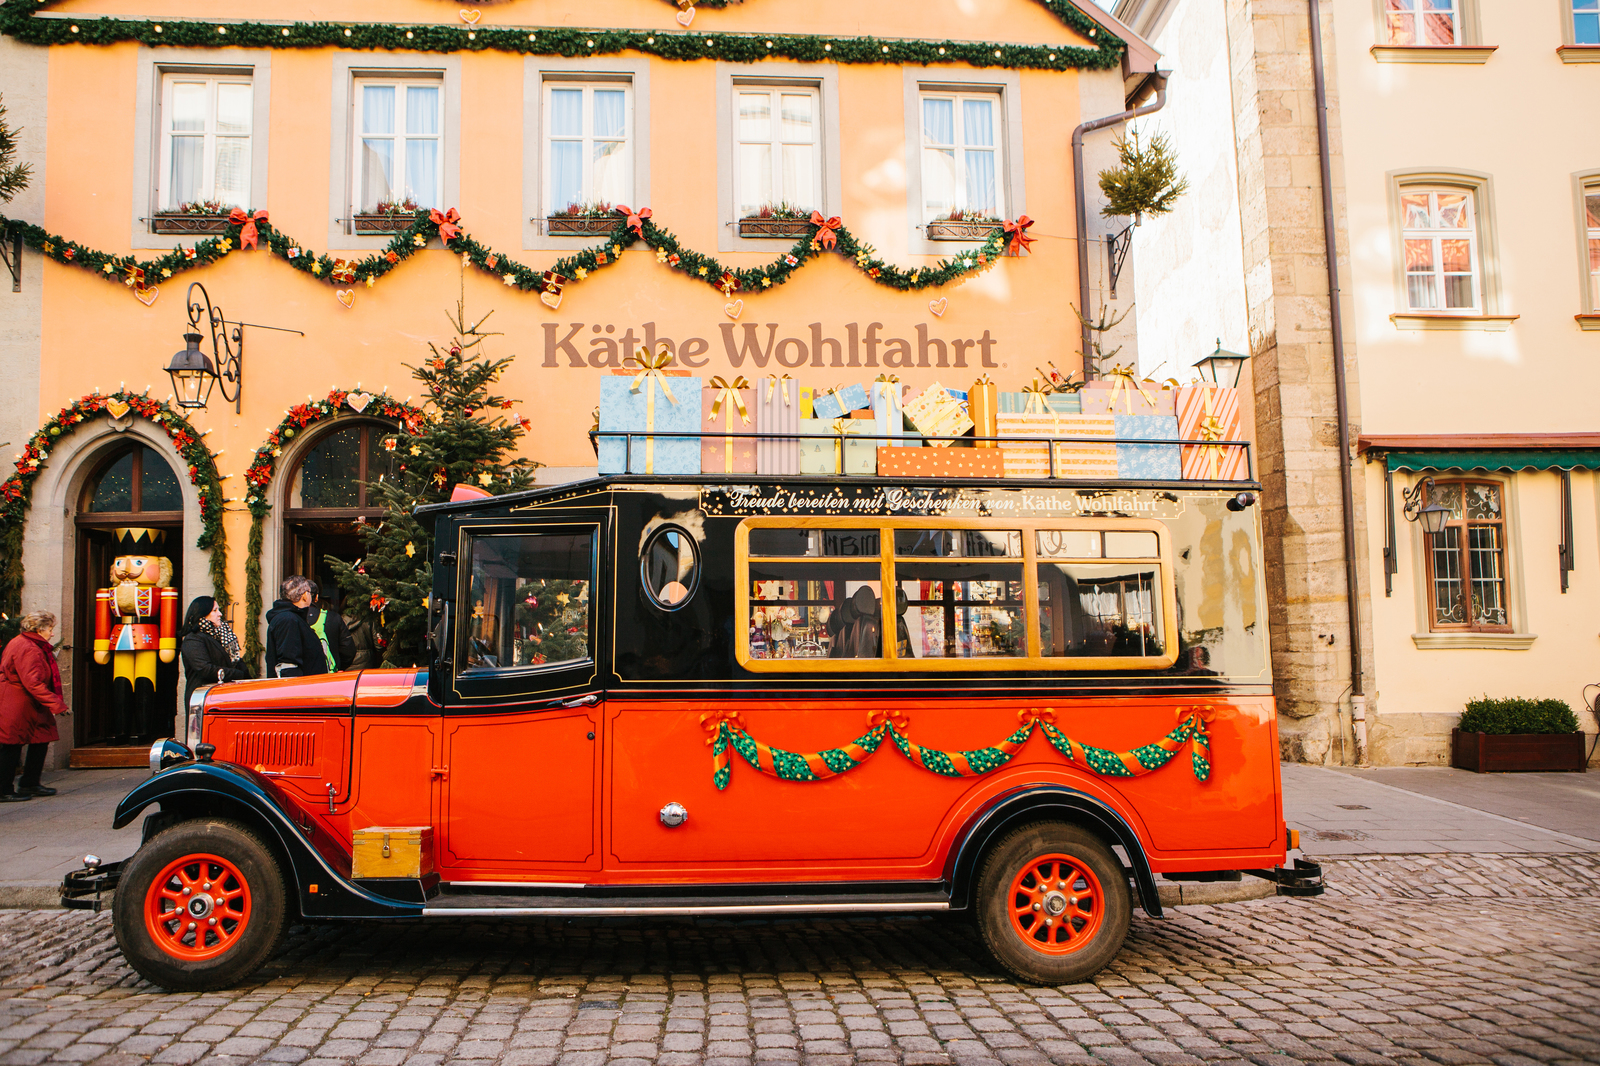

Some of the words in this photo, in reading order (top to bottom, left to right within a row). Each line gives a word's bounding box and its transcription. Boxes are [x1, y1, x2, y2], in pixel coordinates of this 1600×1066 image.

[541, 322, 710, 368] Käthe
[718, 322, 998, 368] Wohlfahrt
[730, 490, 785, 509] Freude
[788, 492, 850, 509] bereiten
[853, 493, 885, 508] mit
[888, 490, 981, 511] Geschenken
[985, 499, 1014, 510] von
[1021, 495, 1072, 511] Käthe
[1076, 495, 1158, 511] Wohlfahrt
